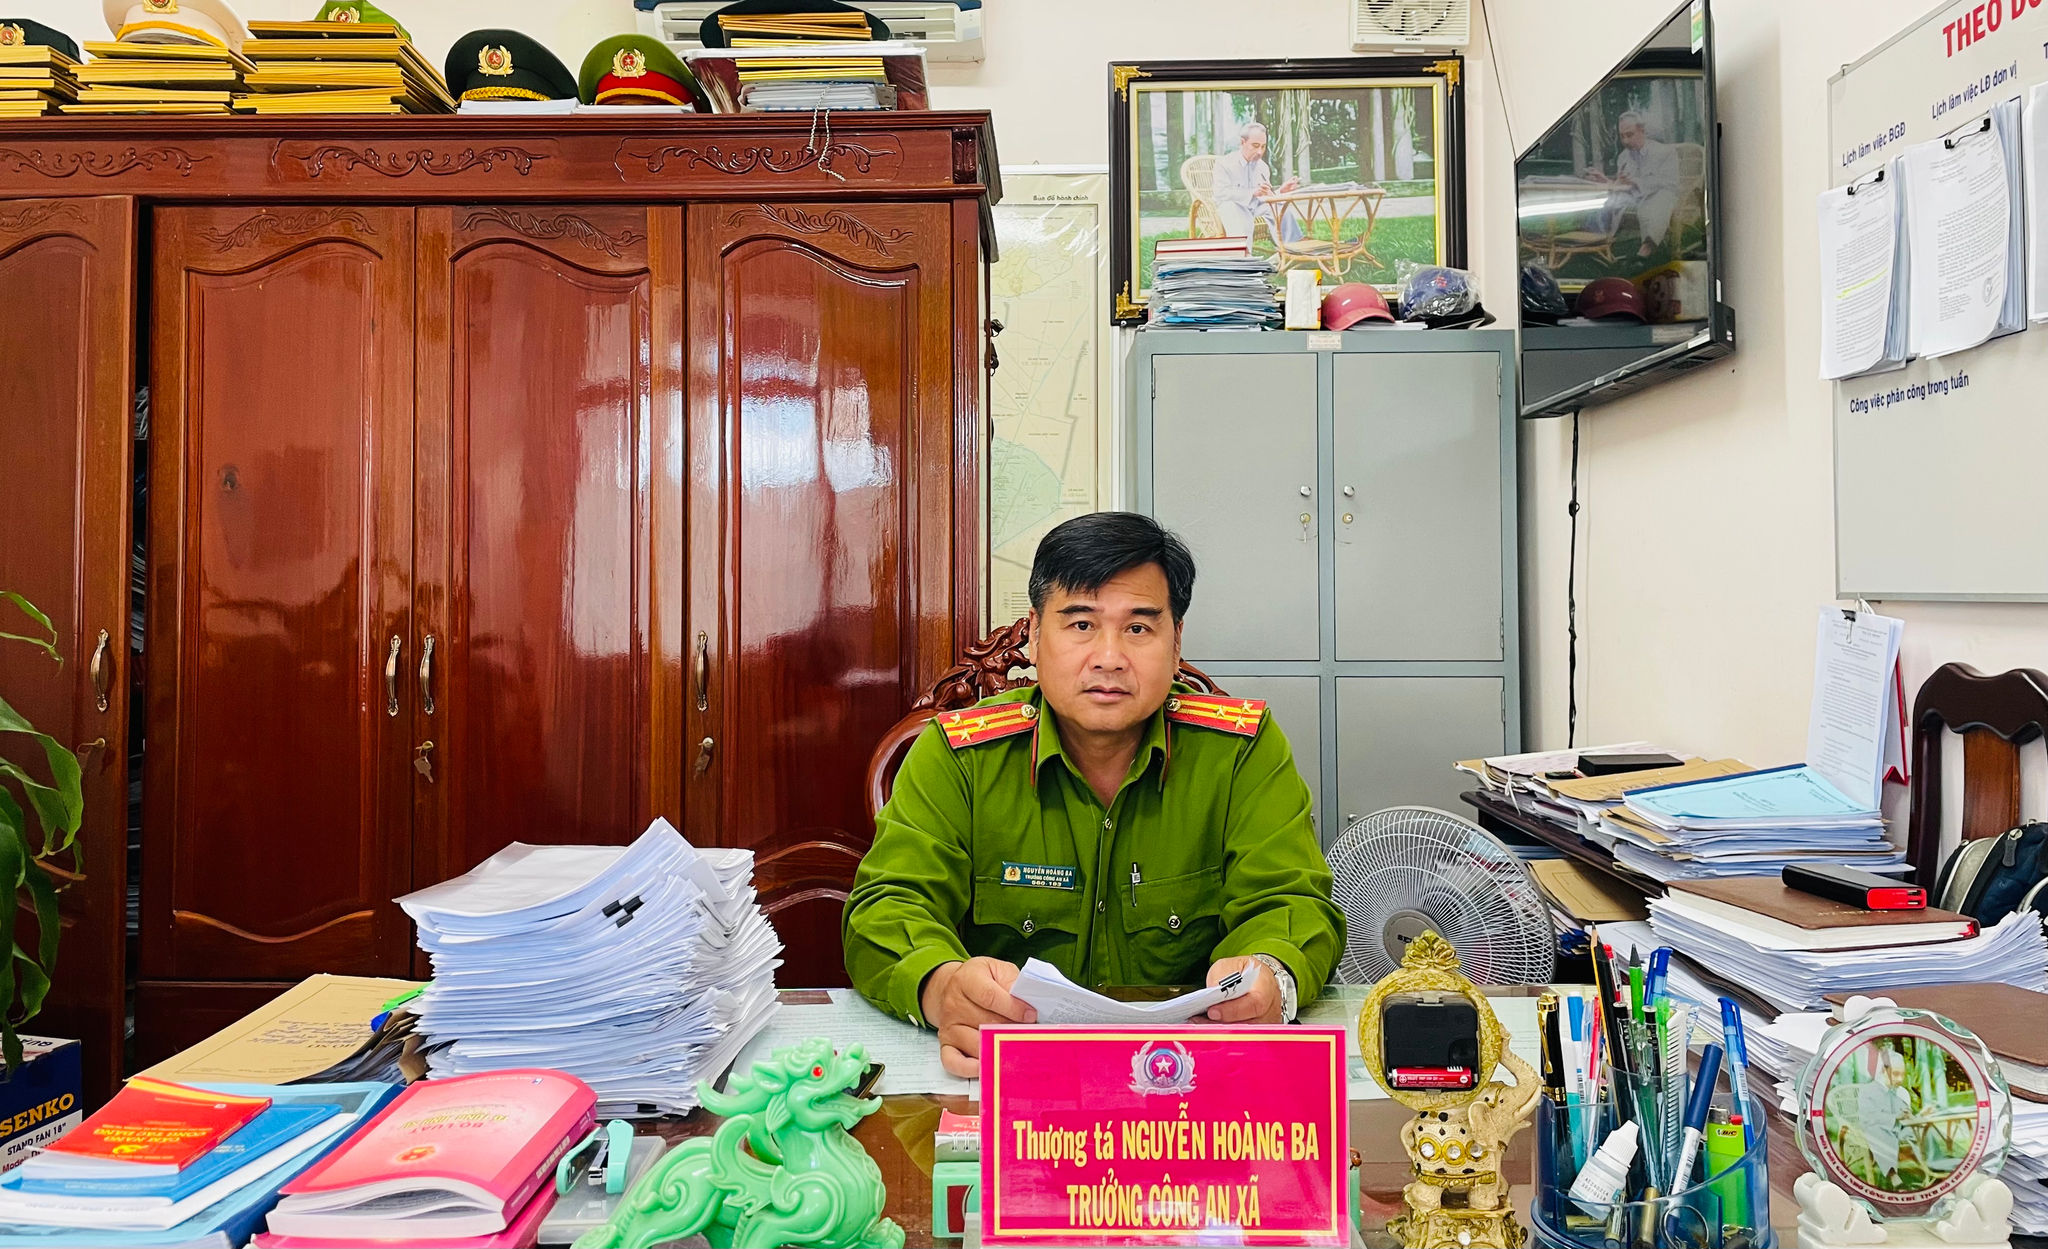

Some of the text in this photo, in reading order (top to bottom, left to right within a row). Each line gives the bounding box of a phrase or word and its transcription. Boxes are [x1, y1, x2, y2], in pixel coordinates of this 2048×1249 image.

[1942, 0, 2003, 58] THEO
[1932, 59, 2017, 120] Lịch làm việc LĐ đơn vị
[1842, 121, 1906, 168] Lịch làm việc BGĐ
[1850, 397, 1869, 414] Công
[1870, 392, 1885, 410] việc
[1886, 387, 1905, 408] phân
[1906, 383, 1926, 400] công
[1927, 379, 1949, 395] trong
[0, 1093, 75, 1138] SENKO
[1012, 1101, 1320, 1168] Thượng tá NGUYỄN HOÀNG BA
[7, 1137, 34, 1156] STAND
[35, 1129, 51, 1144] FAN
[1066, 1167, 1261, 1227] TRƯỞNG CÔNG AN XÃ
